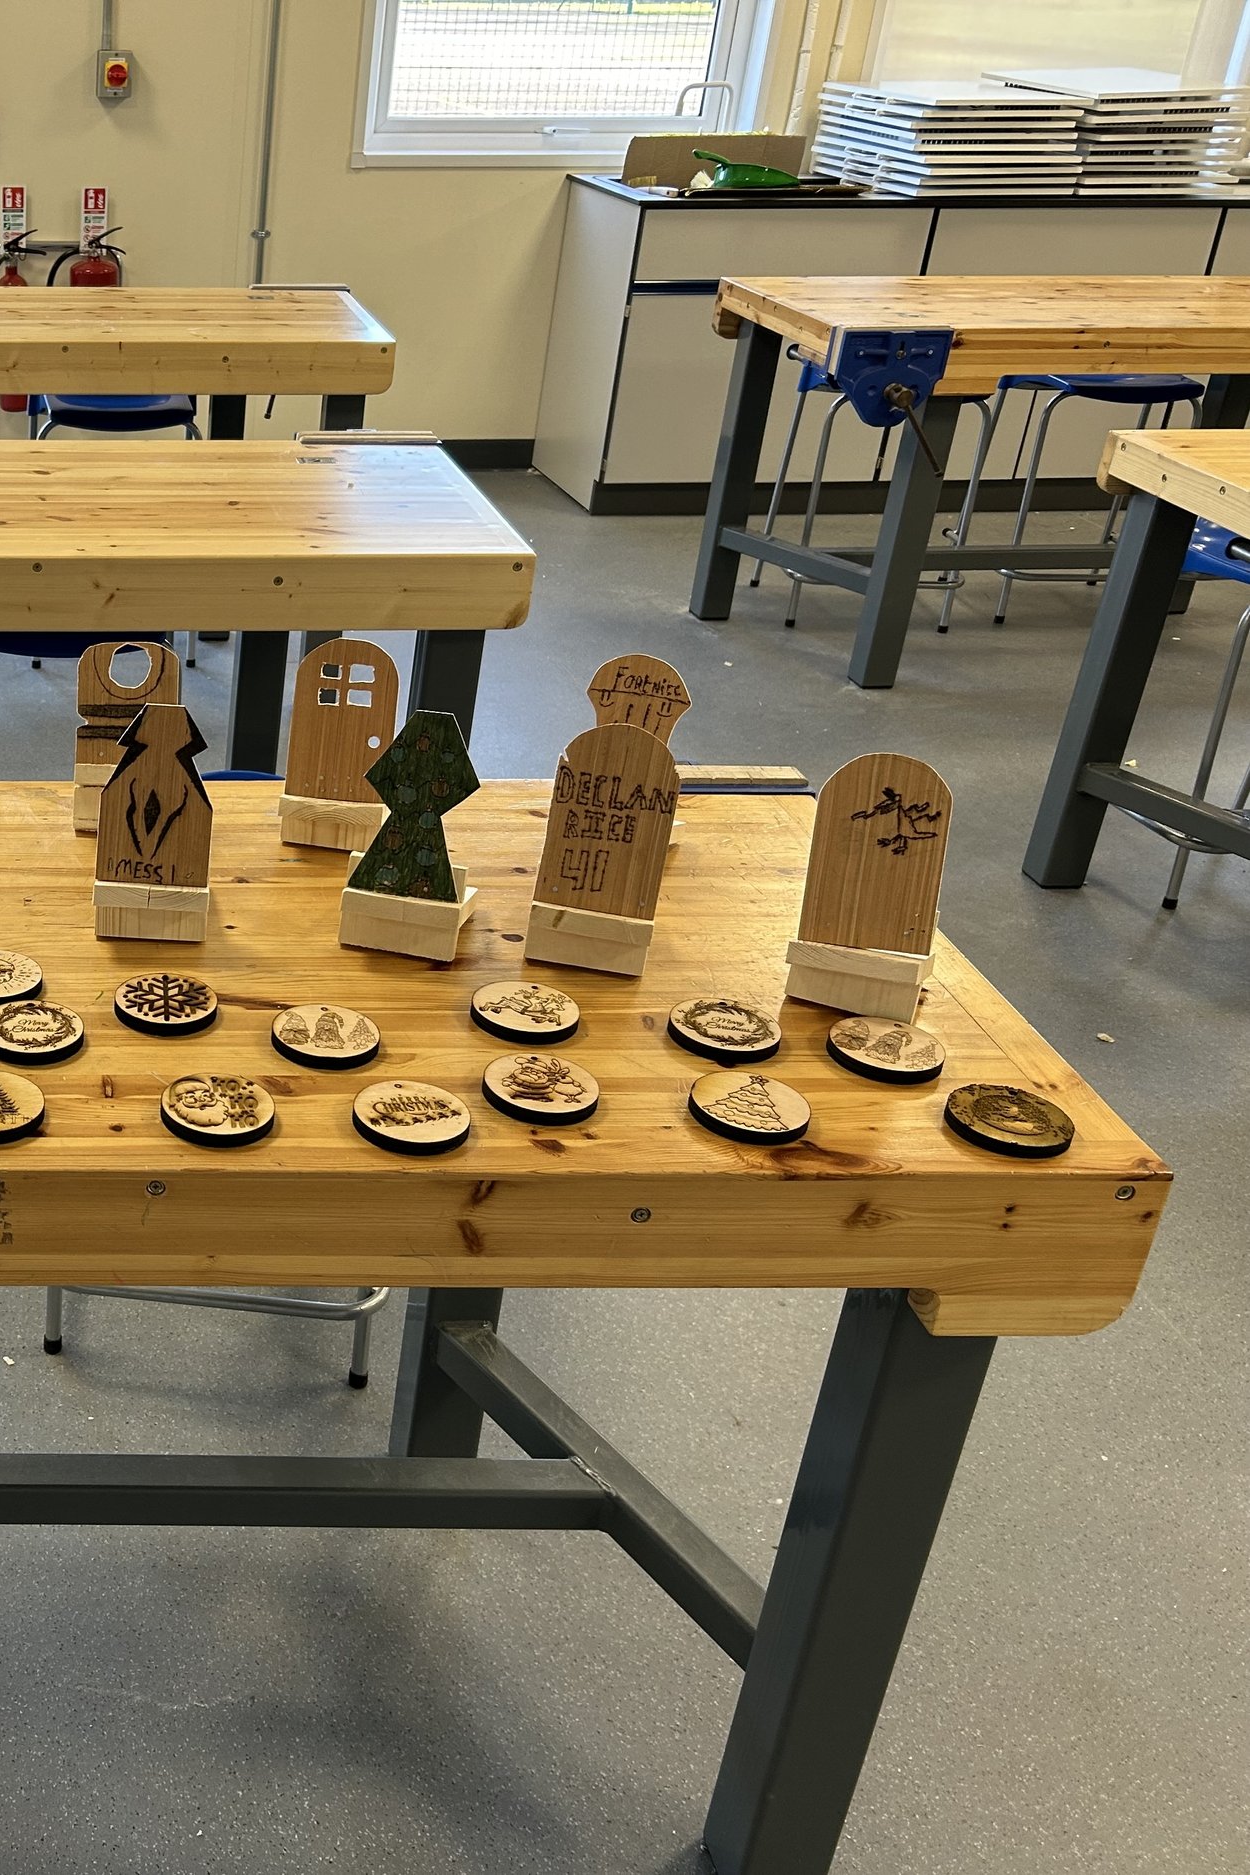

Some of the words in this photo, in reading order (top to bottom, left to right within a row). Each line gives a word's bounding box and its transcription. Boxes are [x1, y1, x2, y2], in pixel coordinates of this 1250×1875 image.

[556, 766, 676, 814] DECLAN
[563, 810, 636, 843] RICE
[560, 849, 610, 892] 41
